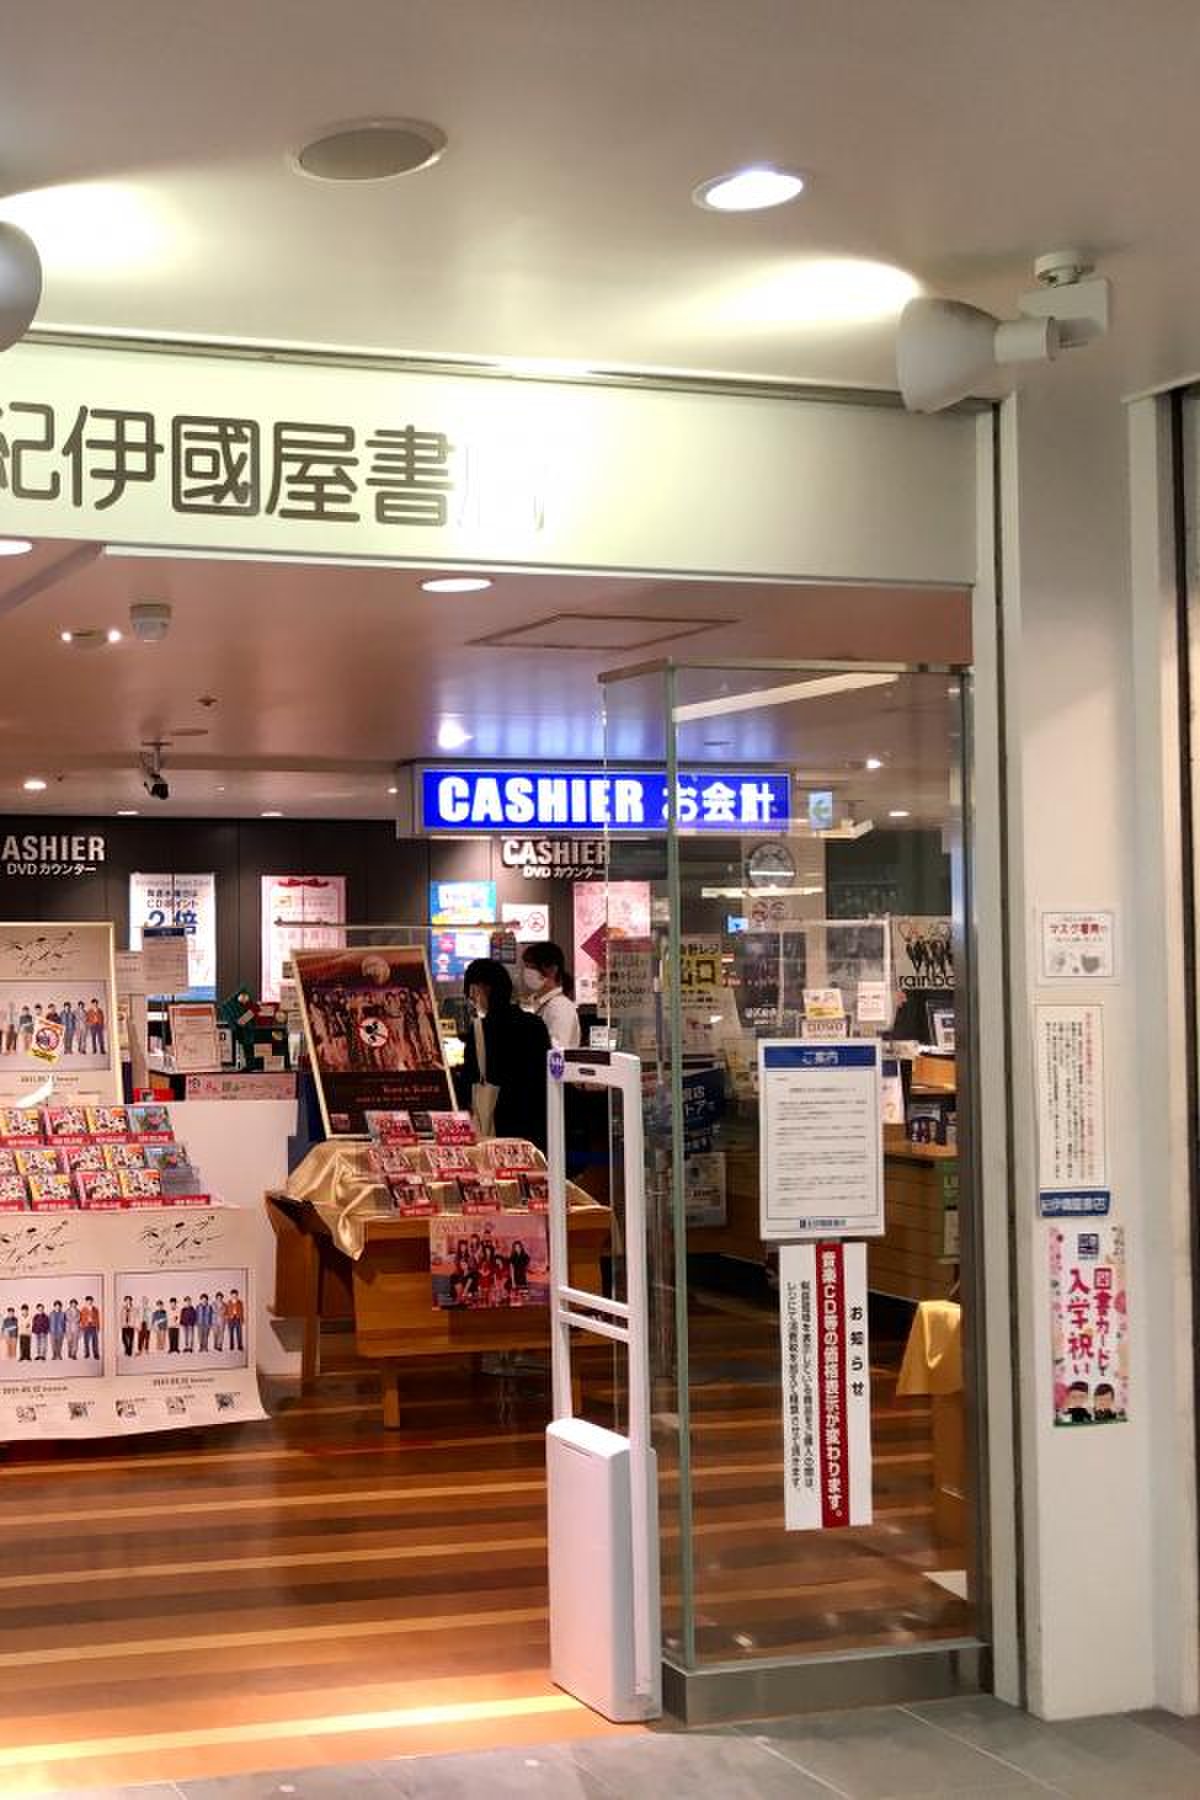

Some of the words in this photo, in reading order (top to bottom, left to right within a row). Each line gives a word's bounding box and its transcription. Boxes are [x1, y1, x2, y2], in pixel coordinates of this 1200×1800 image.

[438, 776, 644, 824] CASHIER
[662, 782, 777, 823] お会計
[502, 839, 611, 866] CASHIER
[849, 1305, 866, 1398] お知らせ
[1067, 1268, 1095, 1375] 入学祝い
